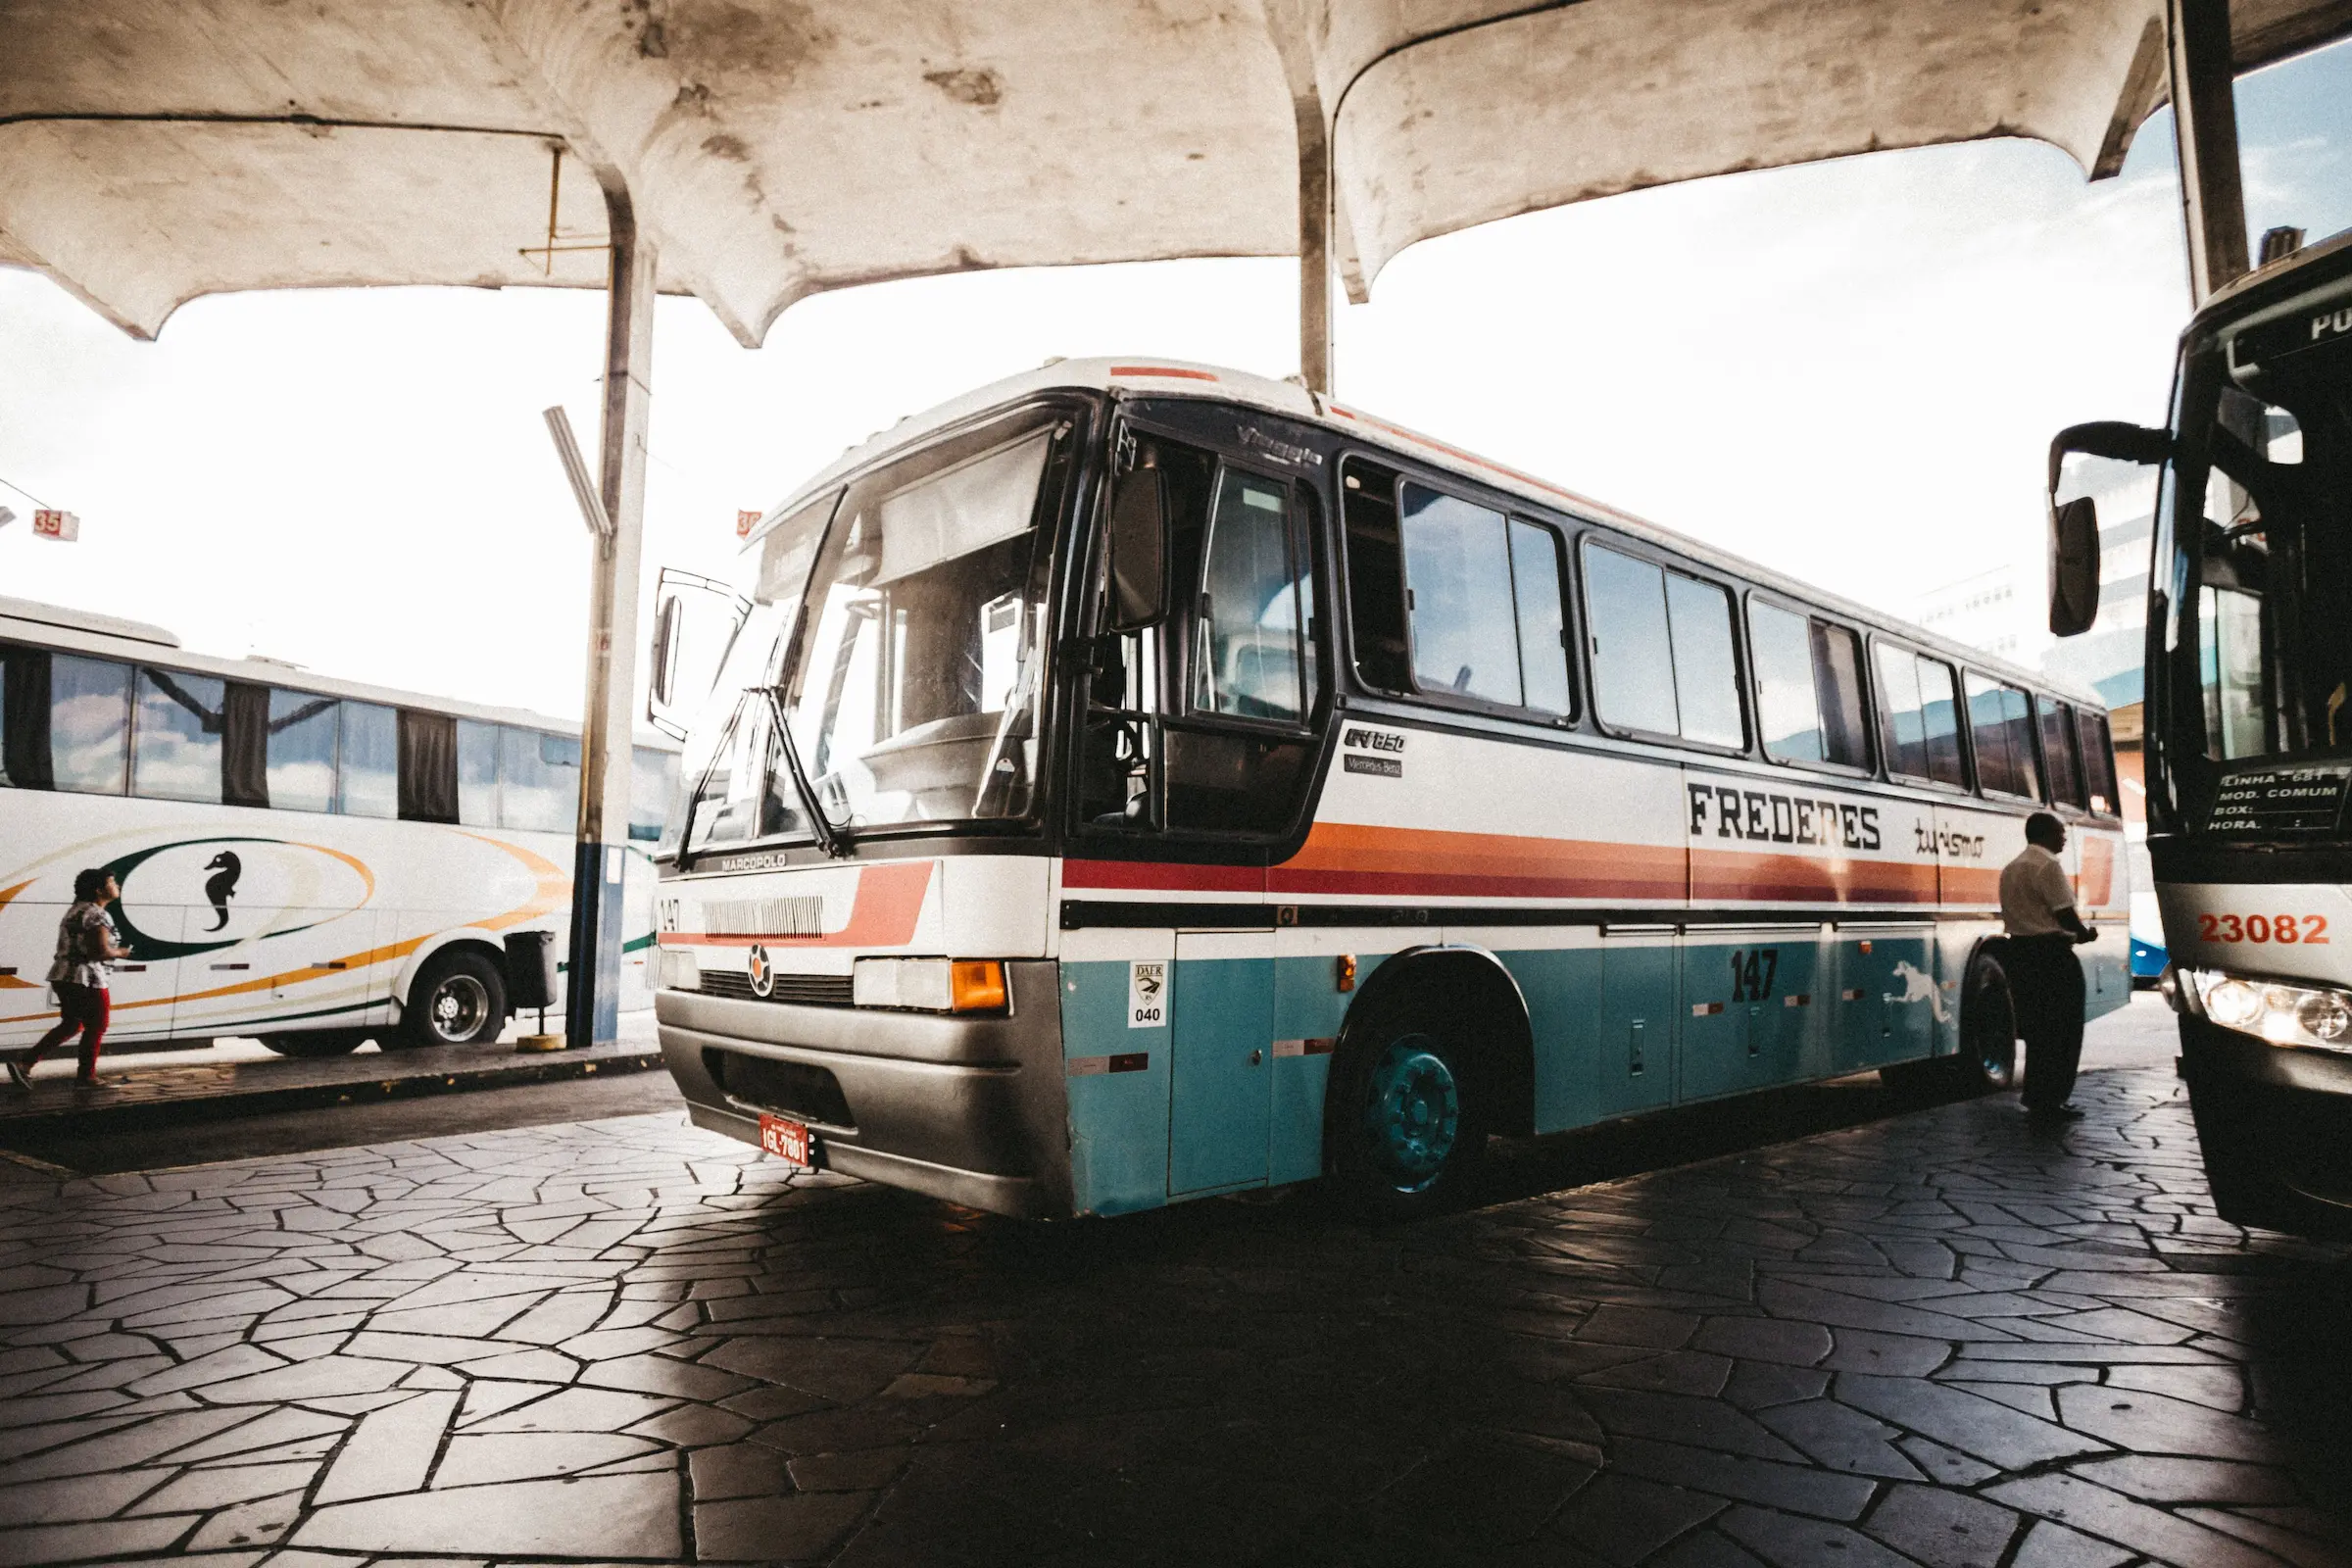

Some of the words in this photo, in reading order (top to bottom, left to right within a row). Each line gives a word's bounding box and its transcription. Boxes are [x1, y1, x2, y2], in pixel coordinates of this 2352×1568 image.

[35, 512, 61, 533] 35
[1372, 731, 1405, 753] 850
[2267, 787, 2338, 799] COMUM
[1688, 783, 1882, 850] FREDERES
[1915, 816, 1984, 858] turismo
[721, 854, 787, 872] MARCOPOLO
[2197, 913, 2330, 944] 23082
[1137, 966, 1162, 975] DAER
[1731, 949, 1778, 1003] 147
[1135, 1007, 1160, 1021] 040
